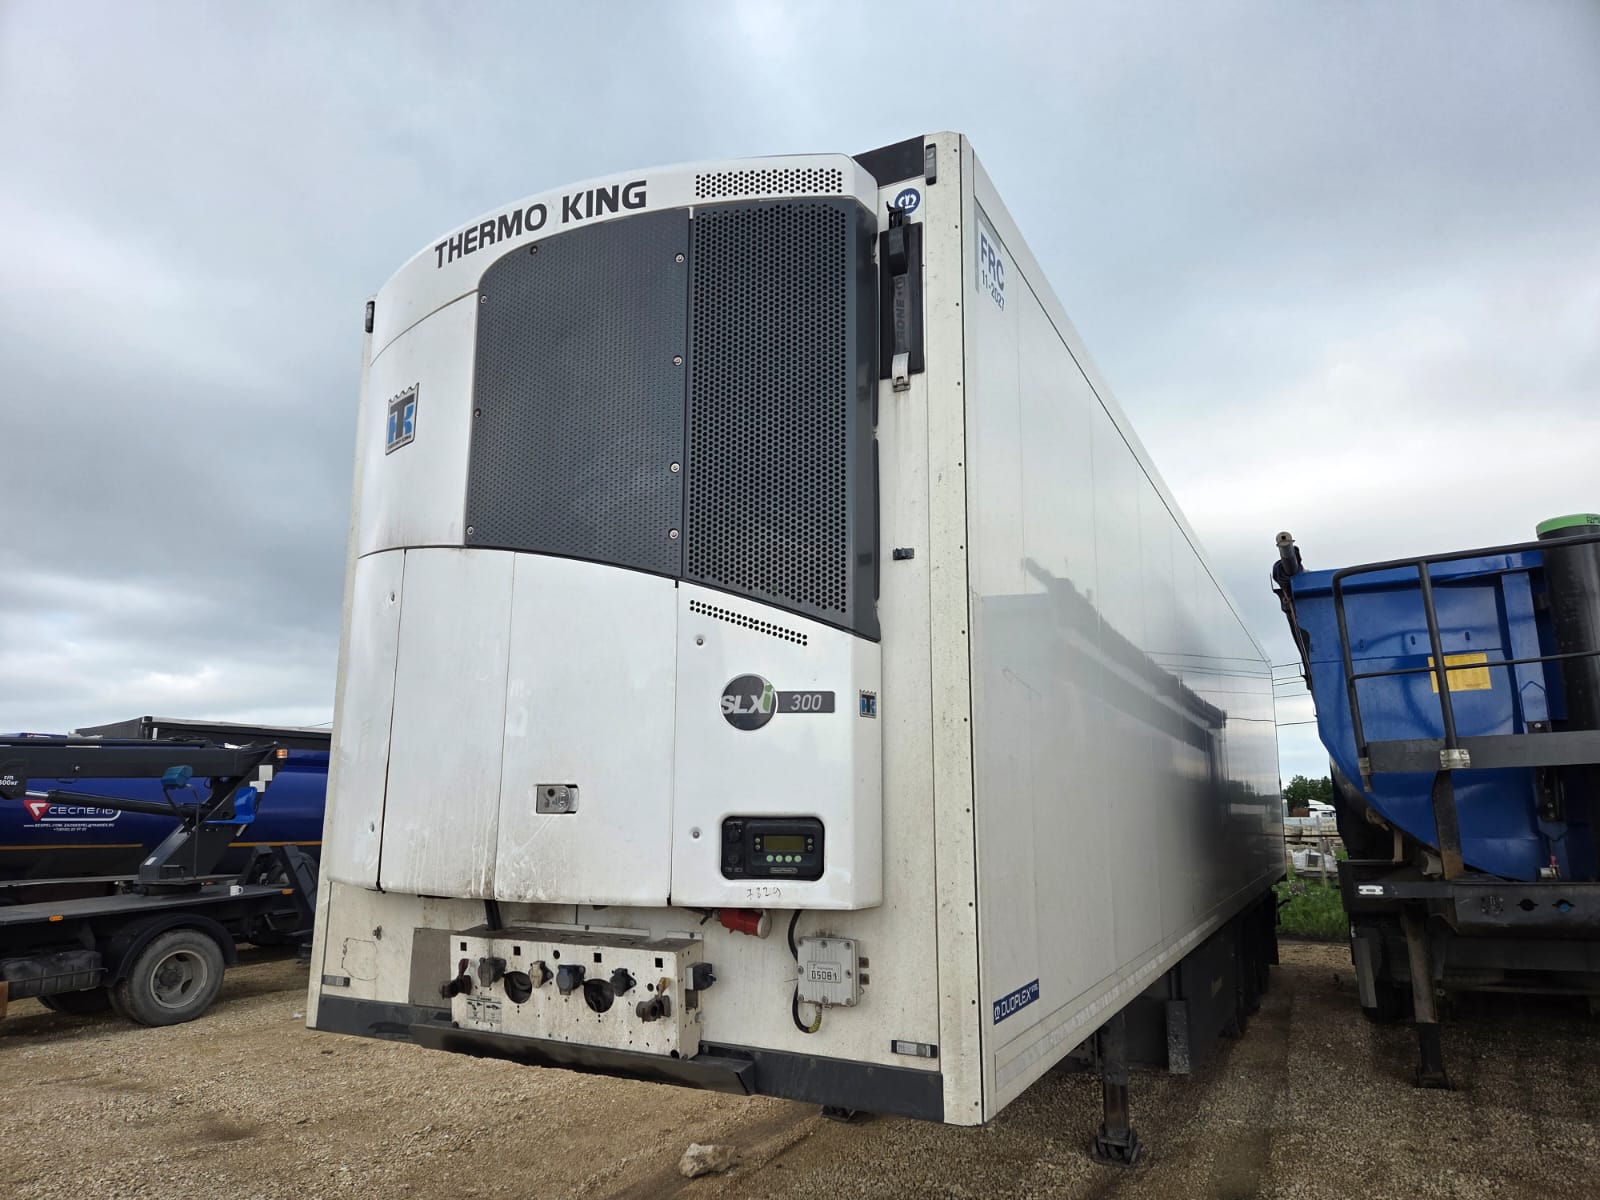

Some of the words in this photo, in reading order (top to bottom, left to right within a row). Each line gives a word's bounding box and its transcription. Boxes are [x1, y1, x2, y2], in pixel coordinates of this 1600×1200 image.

[434, 203, 547, 269] THERMO
[562, 179, 647, 224] KING
[981, 232, 1004, 291] FRC
[721, 683, 774, 714] SLXi
[791, 694, 822, 711] 300
[1001, 988, 1032, 1017] DUOPLEX
